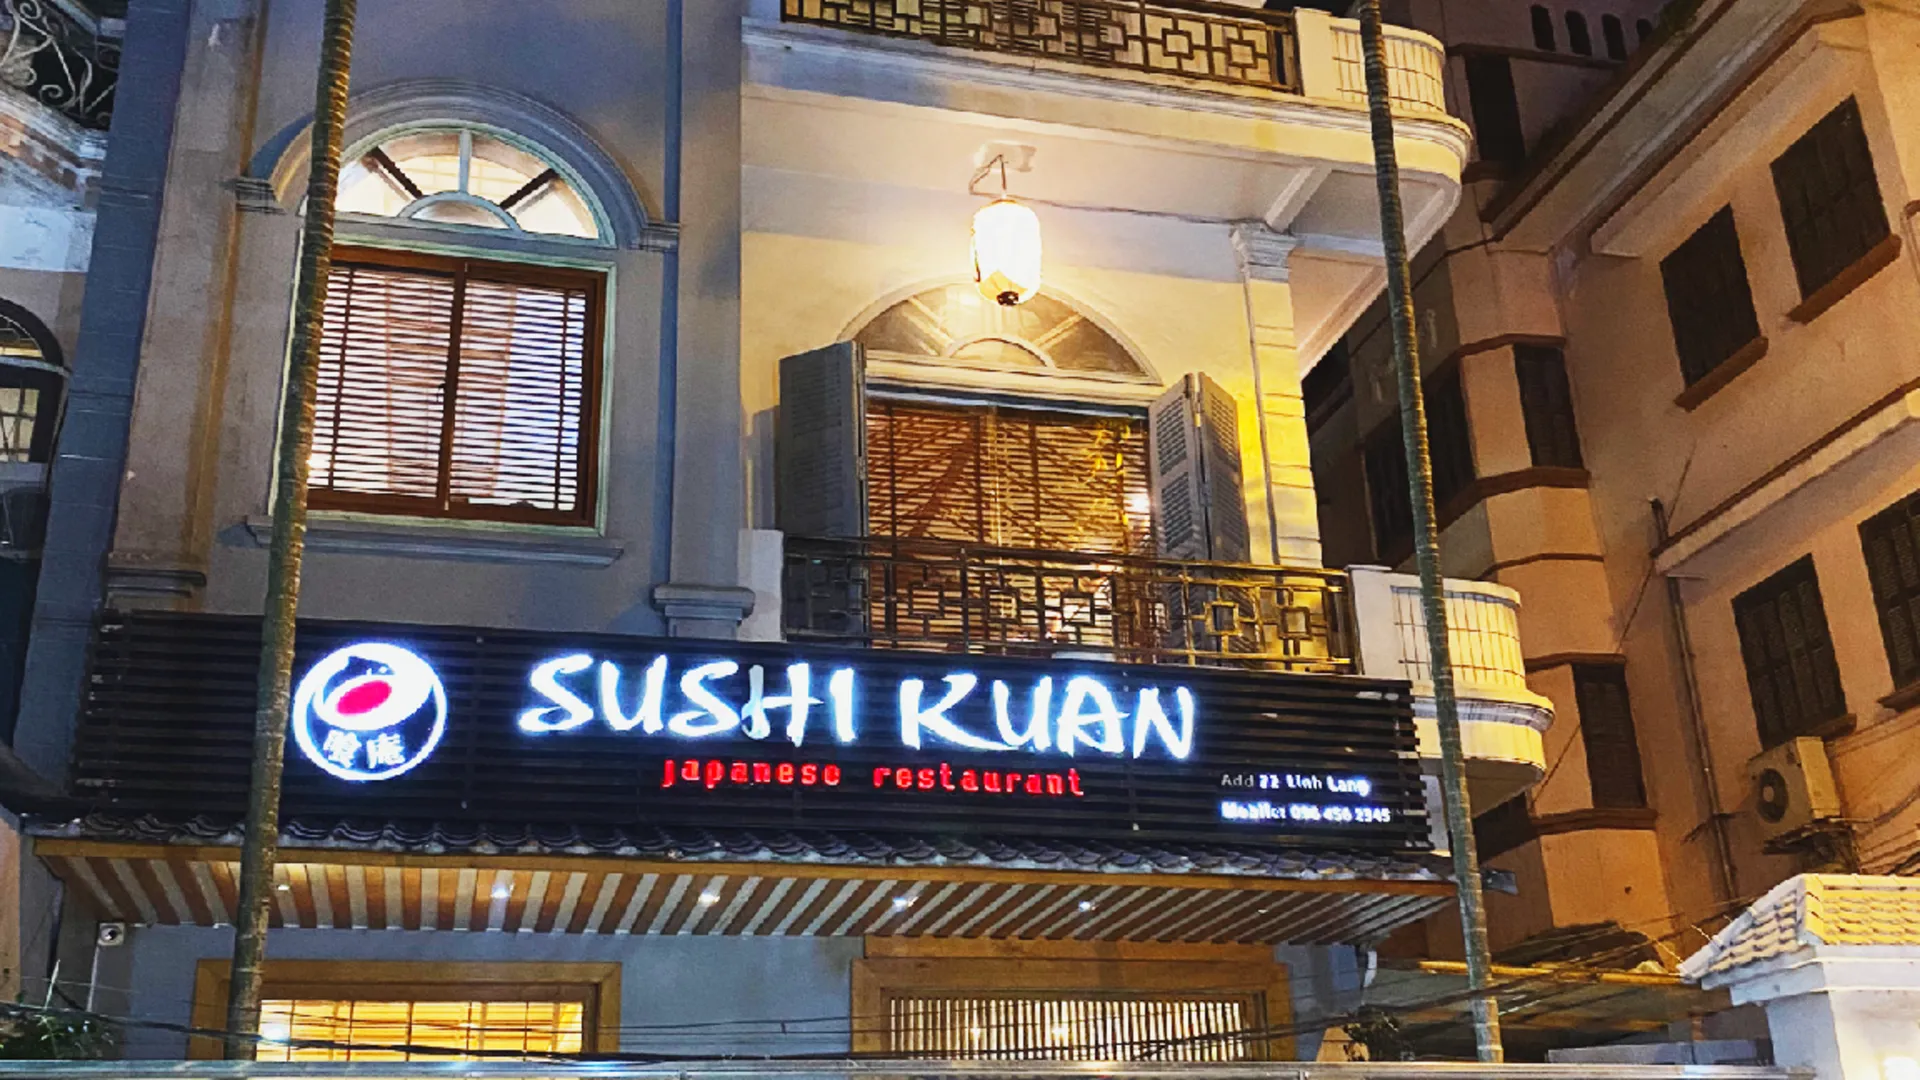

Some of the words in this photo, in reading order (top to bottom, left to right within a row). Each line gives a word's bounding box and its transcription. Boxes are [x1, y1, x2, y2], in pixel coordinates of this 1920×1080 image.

[518, 653, 857, 747] SUSHI
[899, 672, 1196, 760] KUAN
[872, 762, 1085, 797] restaurant
[1286, 774, 1323, 789] Linh
[1326, 775, 1371, 796] Lang
[1322, 806, 1353, 822] 456
[1354, 807, 1391, 823] 2345
